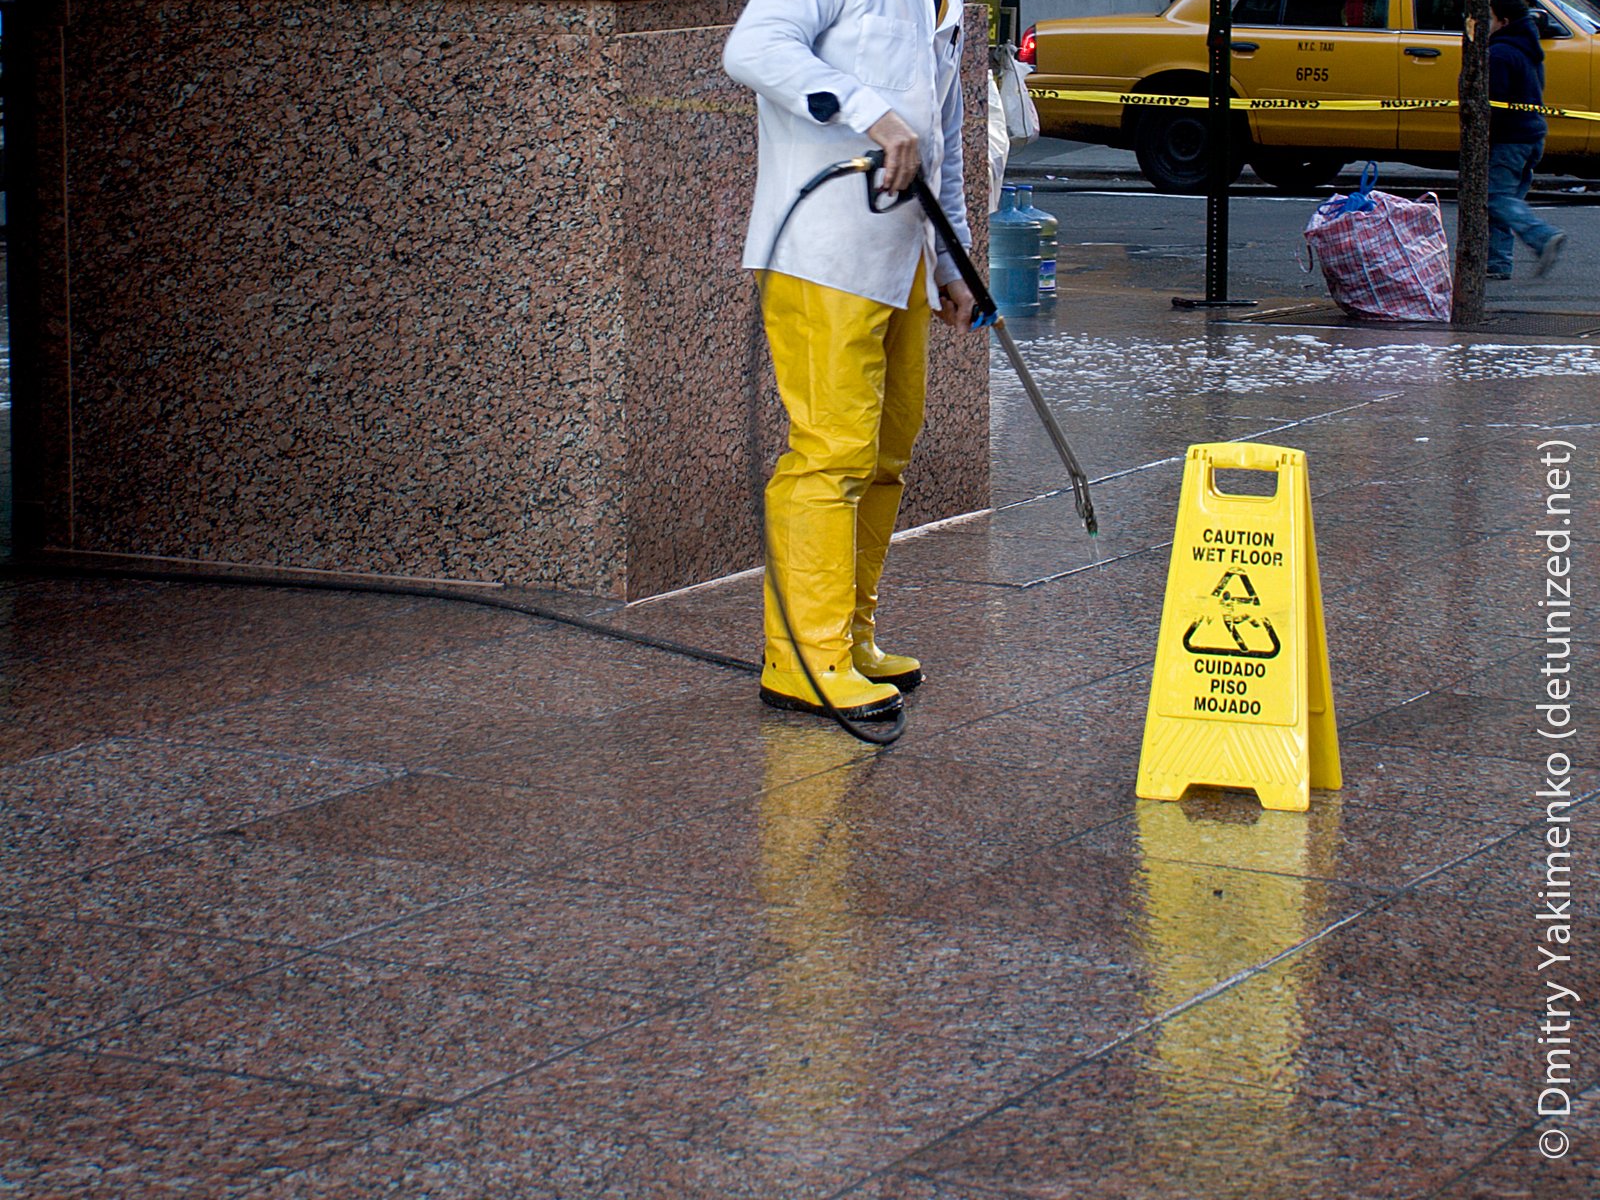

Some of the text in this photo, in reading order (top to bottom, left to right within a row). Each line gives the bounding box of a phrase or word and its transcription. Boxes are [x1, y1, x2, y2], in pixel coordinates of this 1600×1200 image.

[1319, 42, 1335, 51] TAXI
[1296, 67, 1329, 82] 6P55
[1119, 94, 1190, 107] CAUTION
[1250, 99, 1320, 109] CAUTION
[1203, 529, 1274, 547] CAUTION
[1192, 546, 1283, 567] WET FLOOR
[1194, 659, 1266, 678] CUIDADO
[1210, 679, 1247, 695] PISO
[1194, 696, 1261, 715] MOJADO
